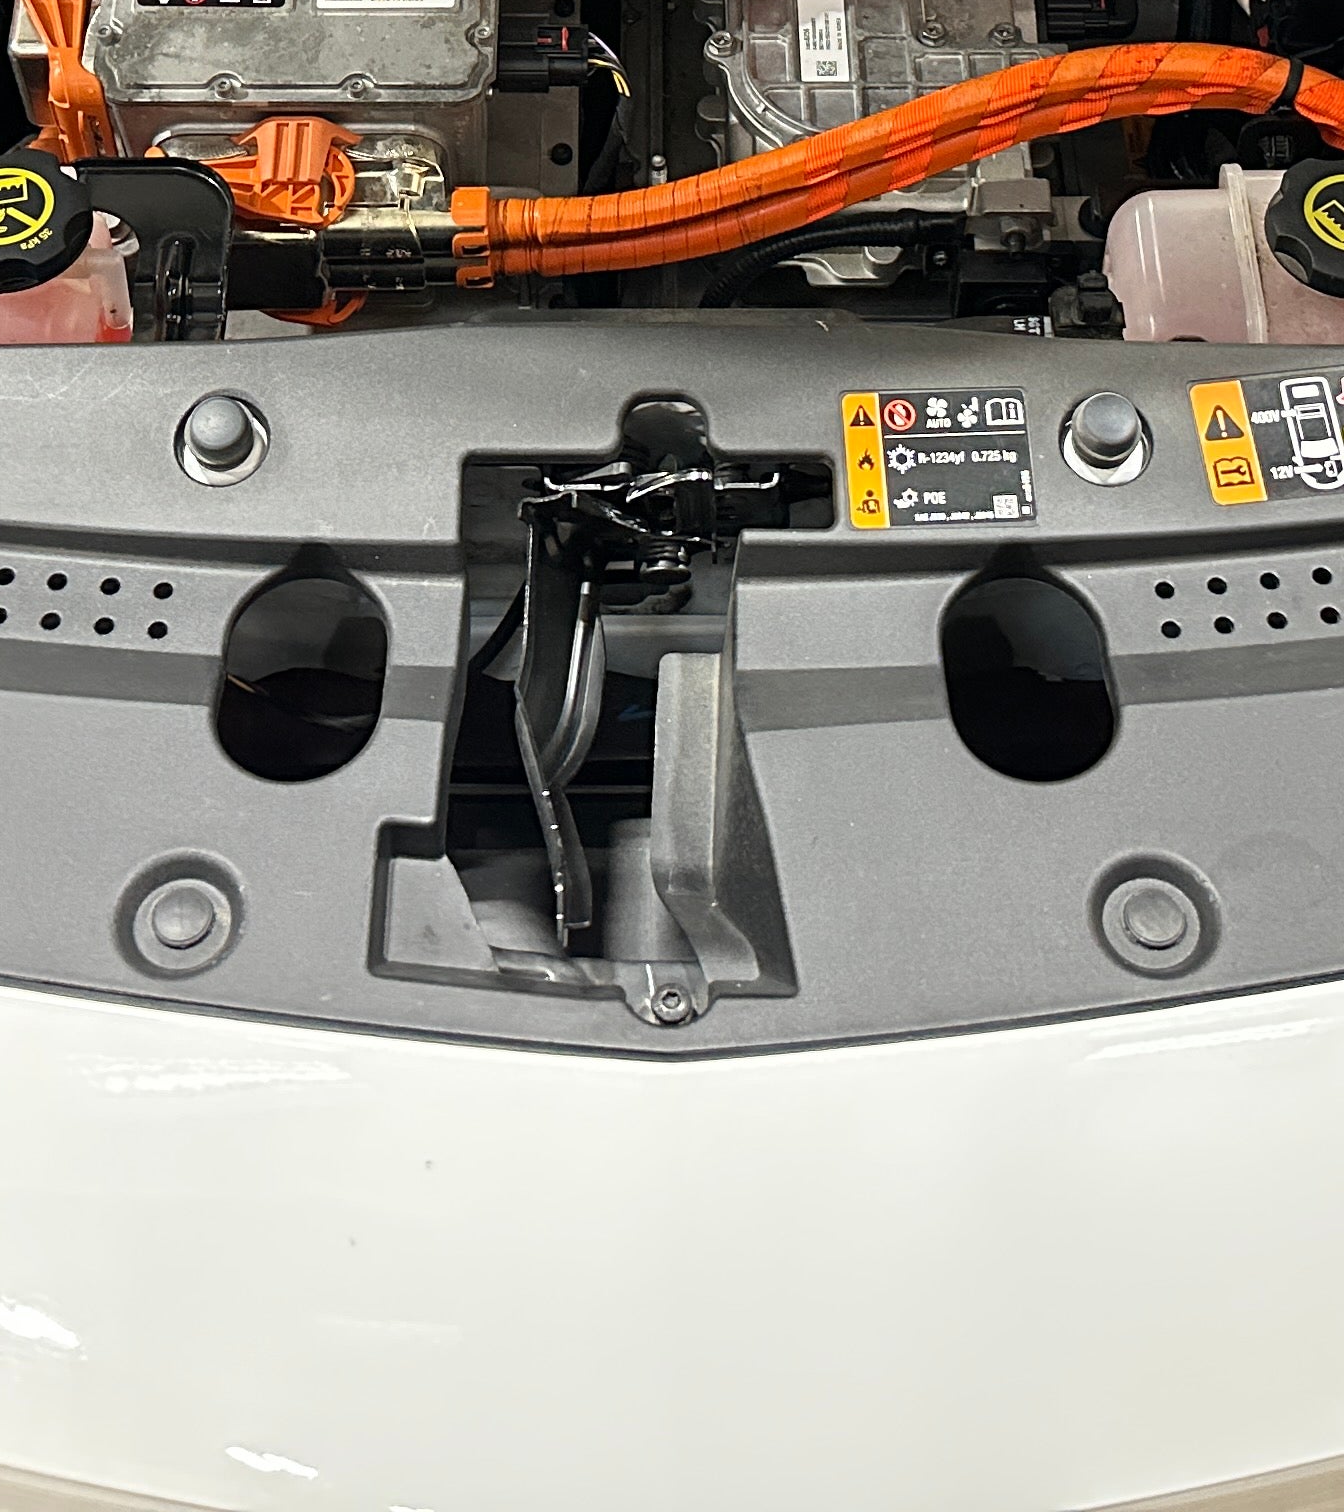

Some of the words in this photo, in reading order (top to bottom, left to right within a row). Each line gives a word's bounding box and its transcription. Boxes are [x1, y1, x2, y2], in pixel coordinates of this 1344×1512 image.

[925, 417, 952, 429] AUTO
[1250, 409, 1281, 425] 400V
[917, 451, 965, 466] R-1234yf
[971, 450, 1002, 463] 0.725
[1002, 450, 1018, 464] kg
[1269, 464, 1295, 480] 12V
[923, 491, 947, 505] POE
